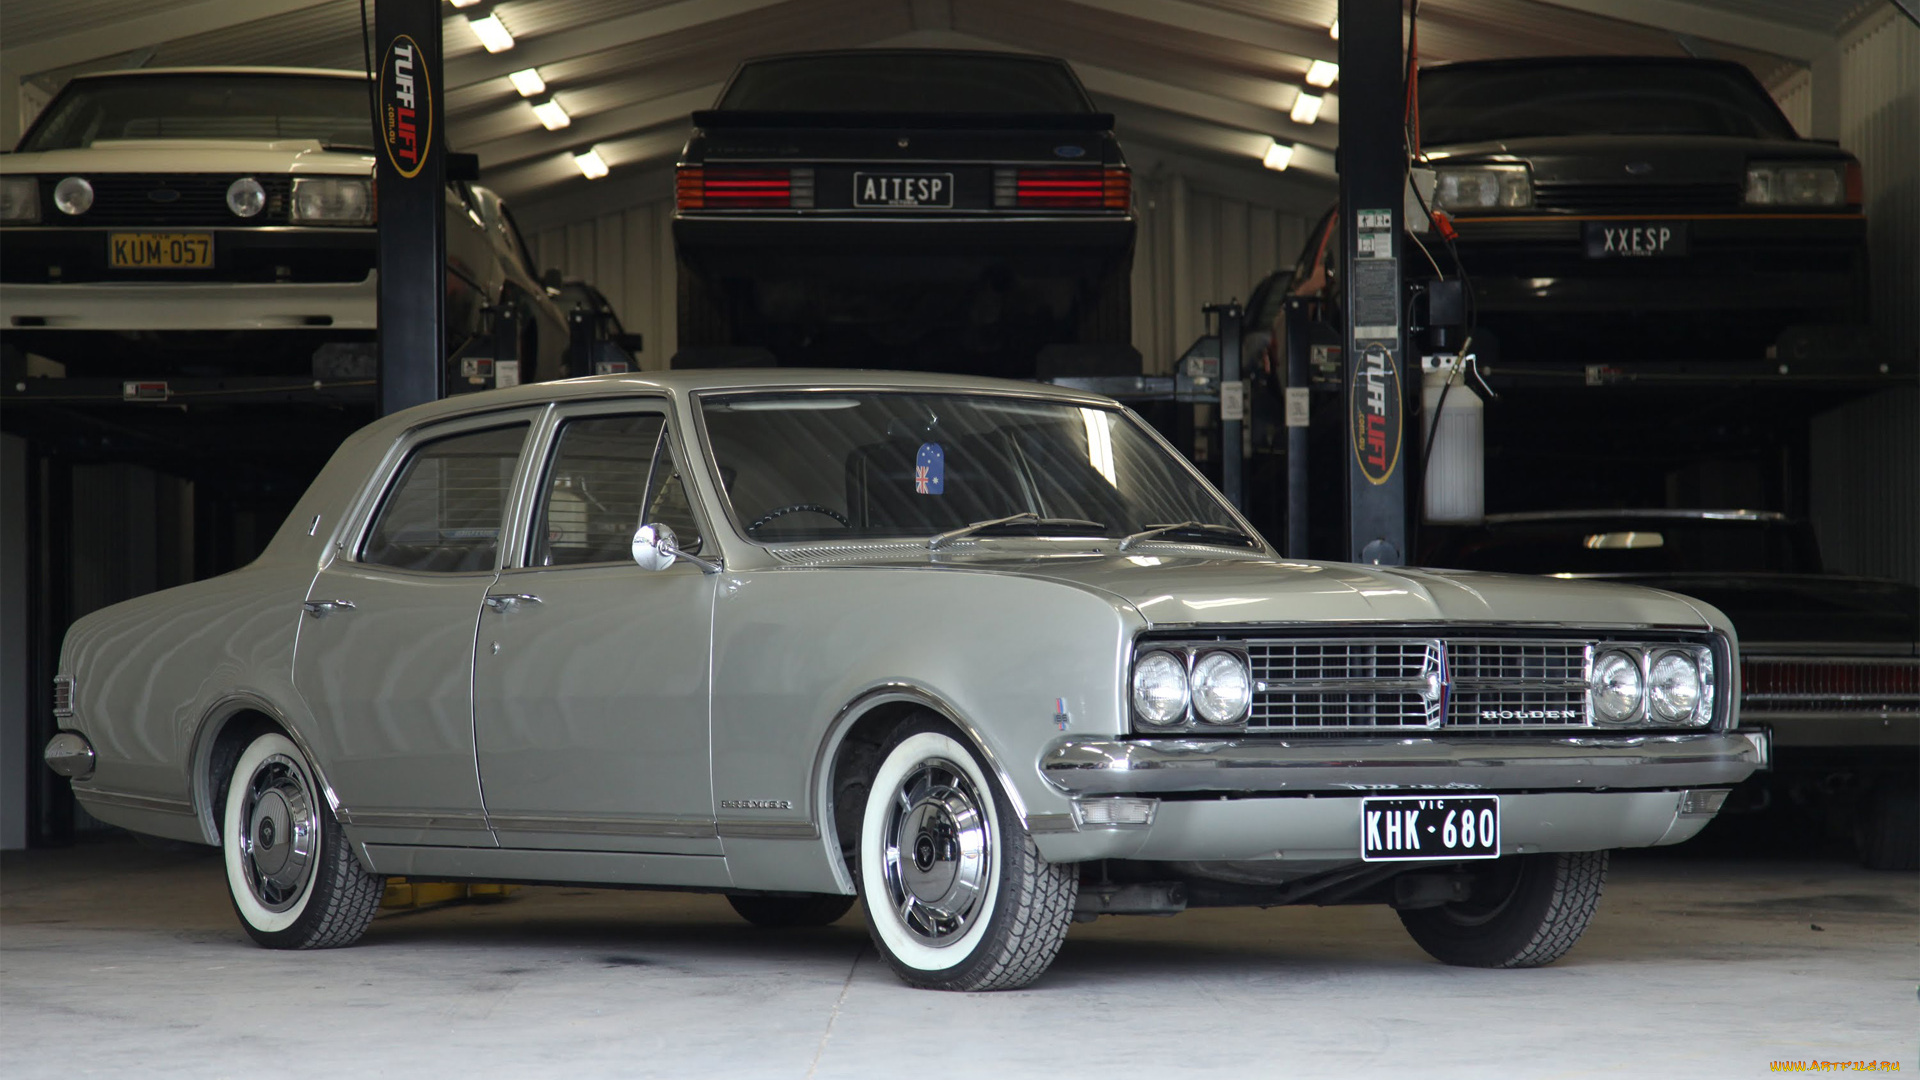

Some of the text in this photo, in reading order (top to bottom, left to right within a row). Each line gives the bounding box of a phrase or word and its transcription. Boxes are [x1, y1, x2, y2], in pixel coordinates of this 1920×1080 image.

[394, 44, 417, 164] TUFFLIFT
[863, 177, 943, 200] AITESP
[1604, 227, 1671, 252] XXESP
[1366, 352, 1386, 471] TUFFLIFT
[1481, 709, 1576, 720] HOLDEN
[721, 800, 793, 810] PREMIER
[1418, 800, 1445, 811] VIC
